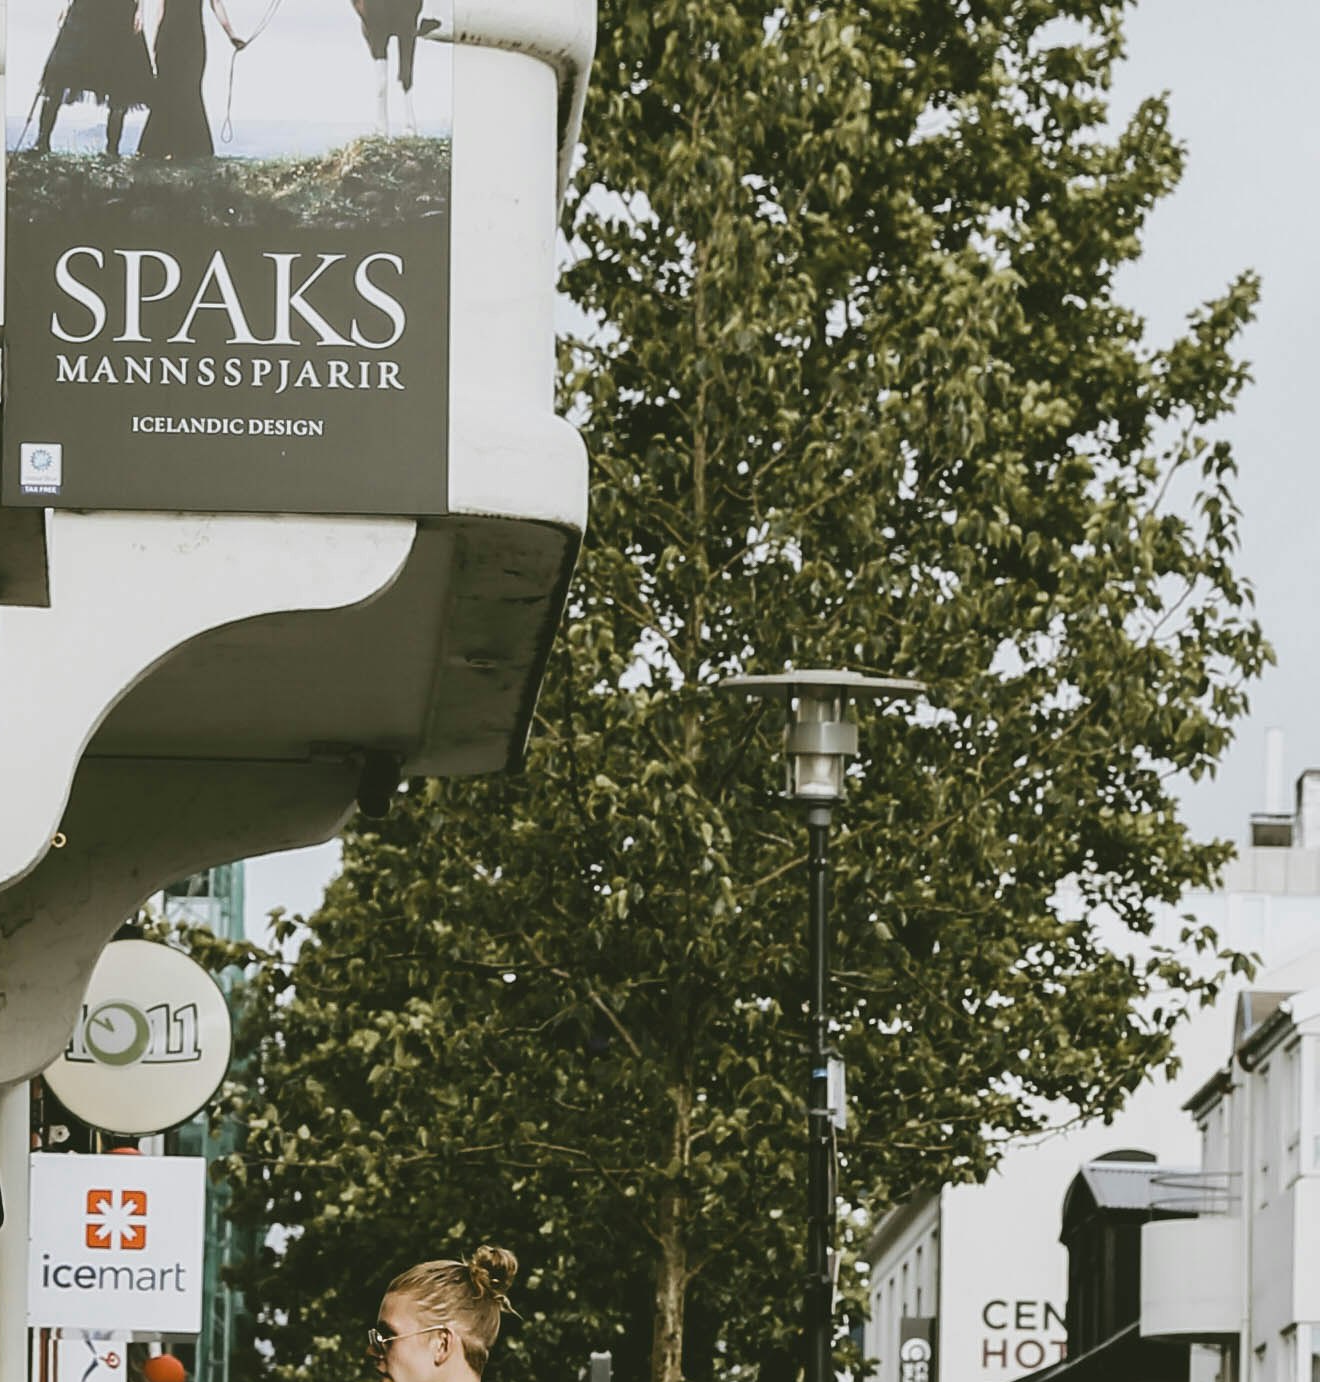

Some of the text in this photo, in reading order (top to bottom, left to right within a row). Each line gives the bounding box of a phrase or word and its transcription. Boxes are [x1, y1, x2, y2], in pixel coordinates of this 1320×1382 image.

[51, 247, 407, 349] SPAKS
[56, 355, 405, 393] MANNSSPJARIR
[132, 416, 324, 436] ICELANDIC DESIGN
[42, 1253, 186, 1292] icemart
